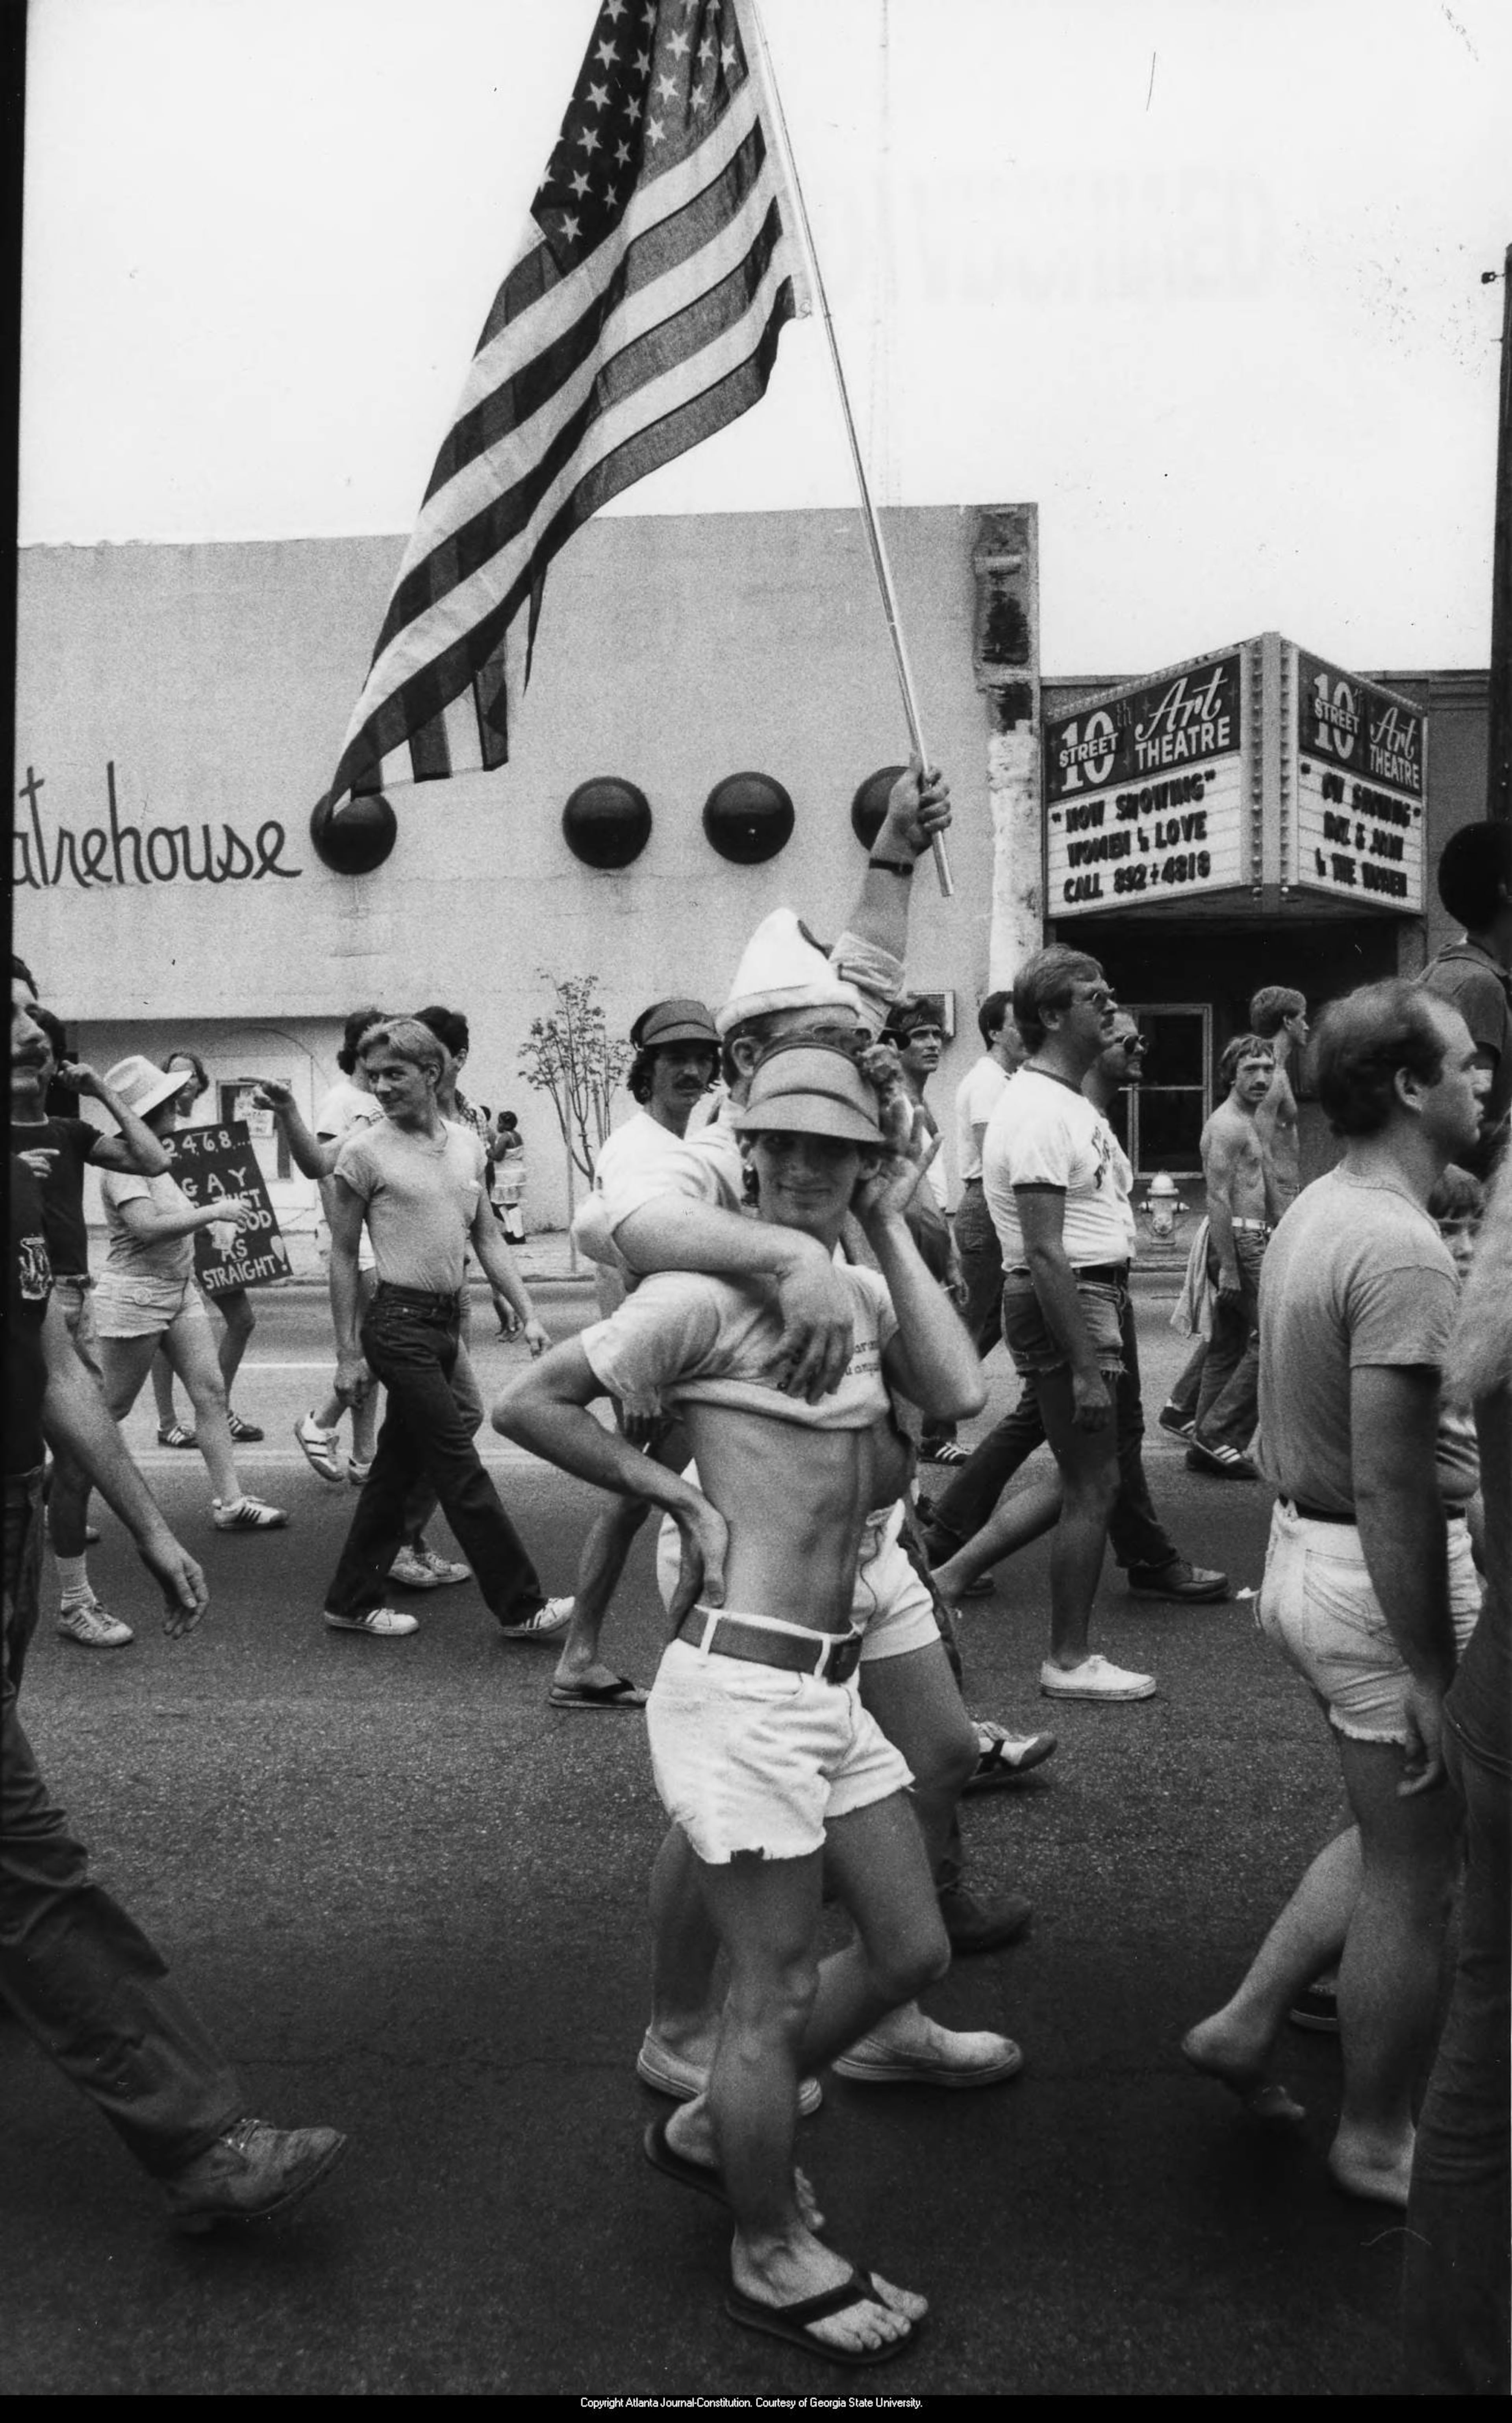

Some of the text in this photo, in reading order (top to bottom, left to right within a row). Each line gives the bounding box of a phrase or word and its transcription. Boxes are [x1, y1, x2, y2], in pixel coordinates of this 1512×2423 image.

[1135, 667, 1228, 742] Art
[1315, 698, 1360, 734] STREET
[1060, 732, 1119, 768] STREET
[1135, 716, 1230, 770] THEATRE
[1370, 707, 1418, 760] Art
[1370, 743, 1419, 790] THEATRE
[1155, 810, 1207, 849] LOVE
[1064, 873, 1103, 904] CALL
[181, 1166, 246, 1198] GAY
